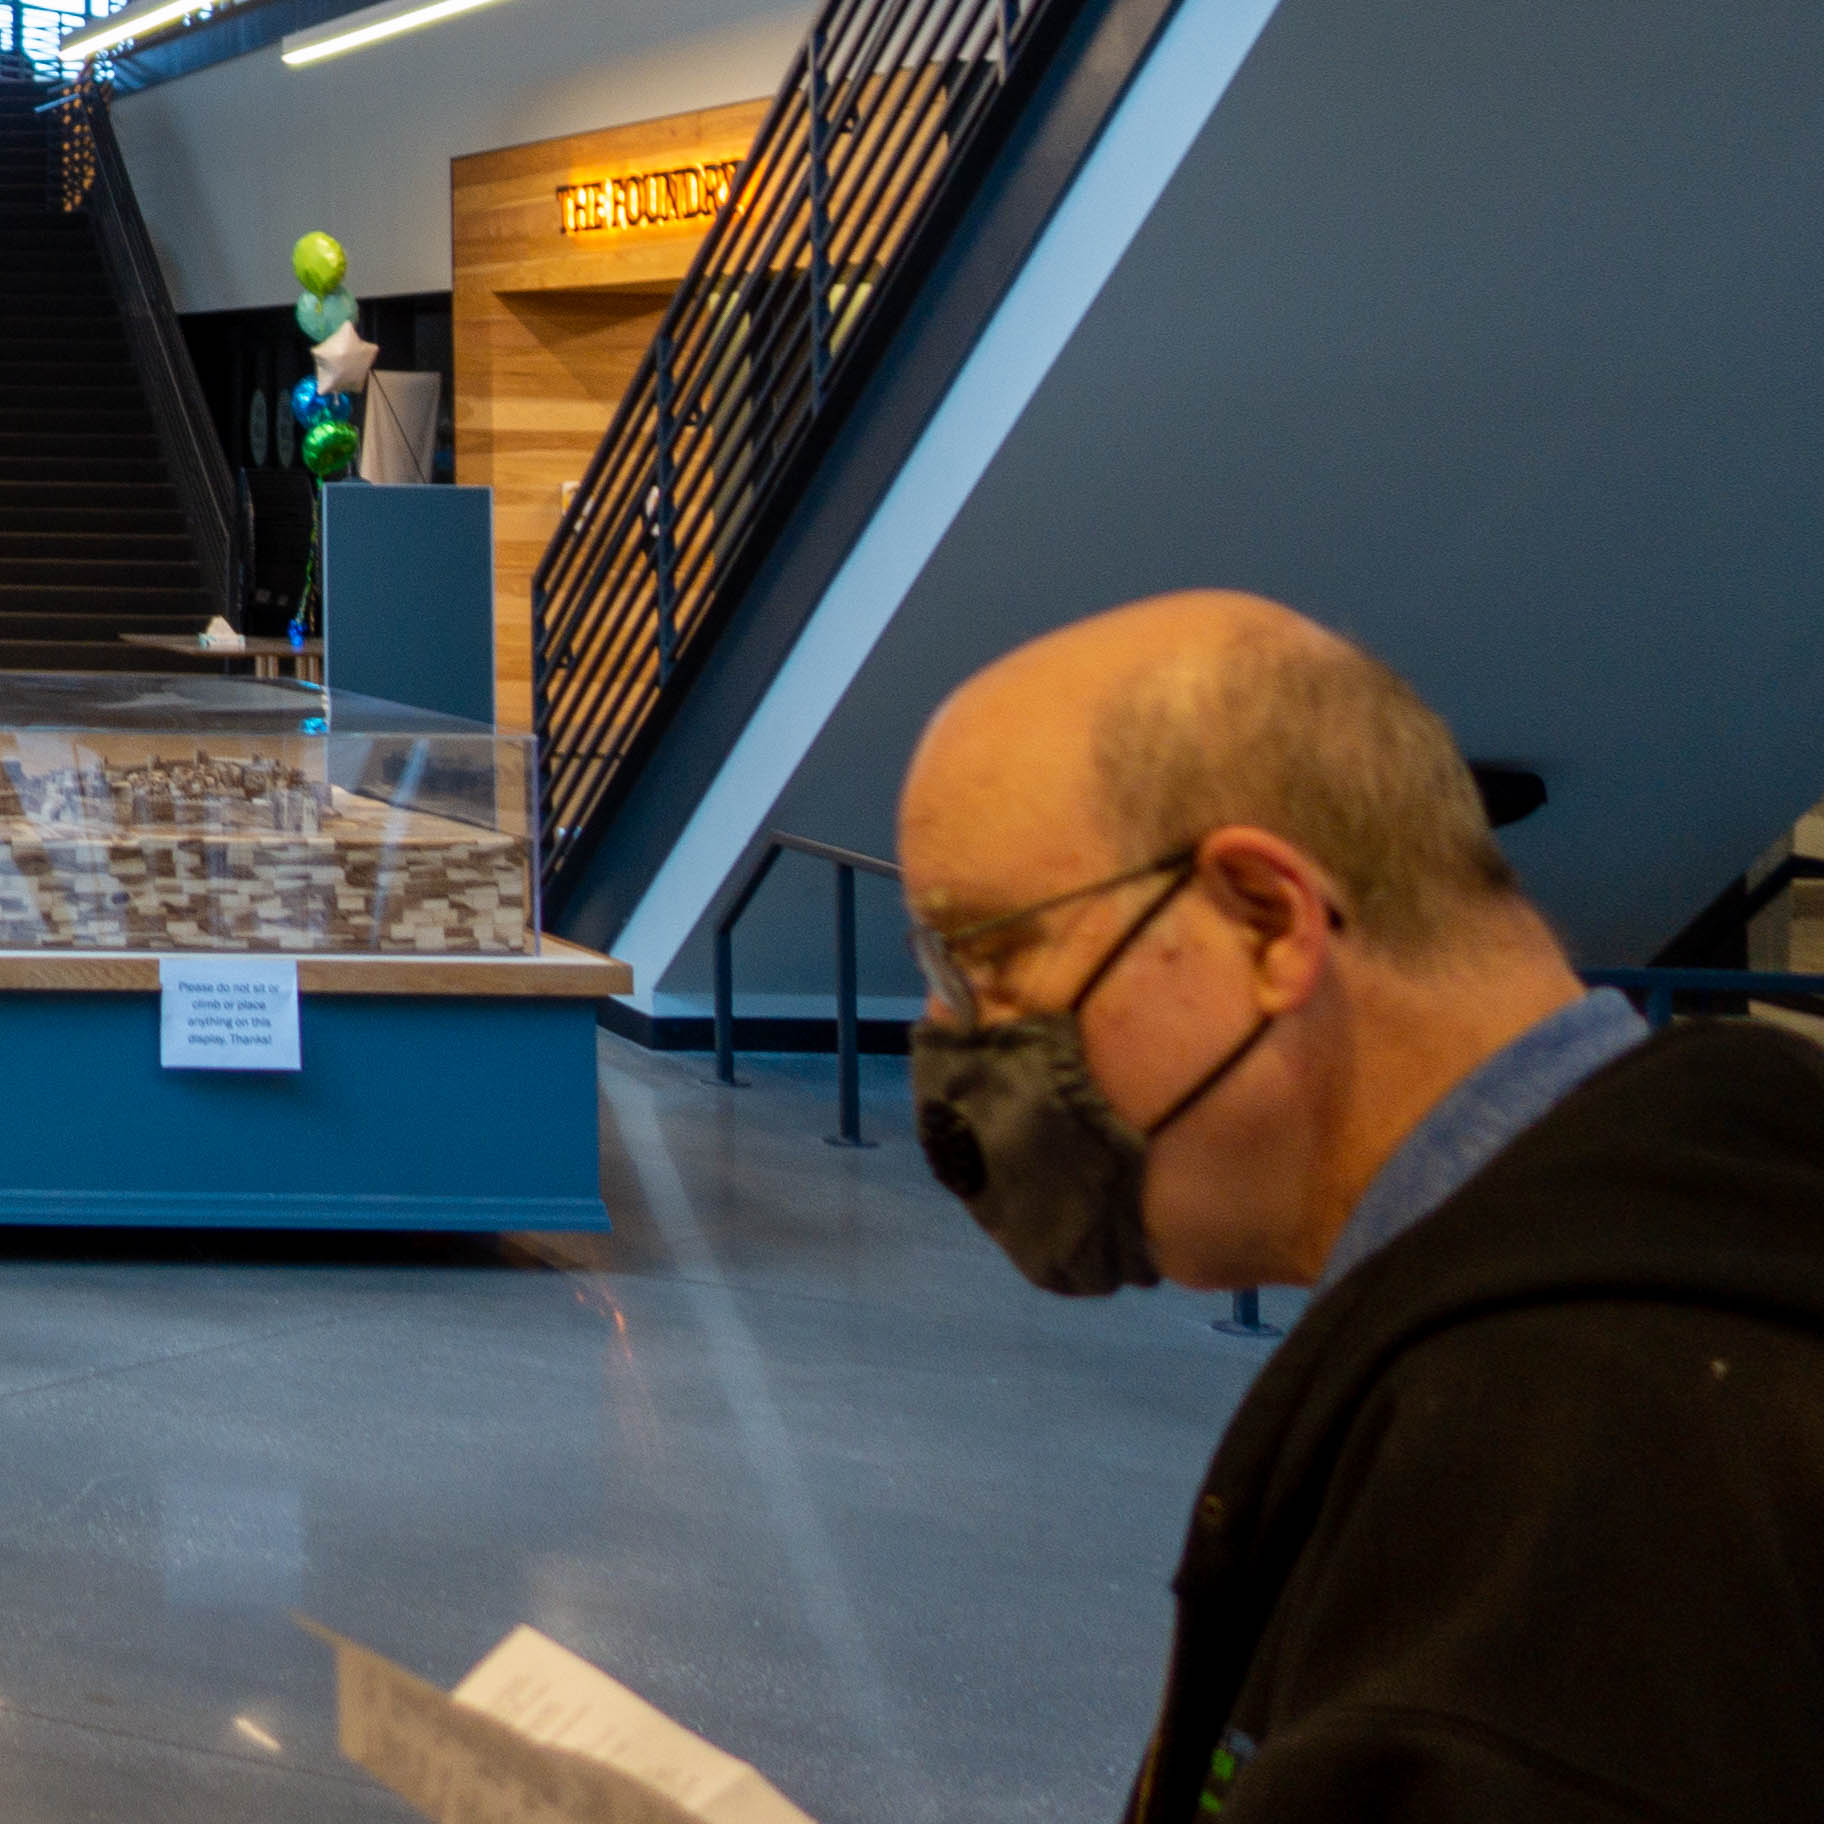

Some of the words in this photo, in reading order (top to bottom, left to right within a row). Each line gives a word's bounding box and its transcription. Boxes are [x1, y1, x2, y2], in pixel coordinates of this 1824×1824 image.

[557, 183, 604, 233] THE
[178, 981, 214, 993] Please
[216, 983, 231, 993] do
[233, 983, 250, 993] not
[253, 983, 266, 993] sit
[268, 984, 280, 993] or
[192, 1000, 221, 1010] climb
[223, 1001, 234, 1010] or
[237, 1000, 266, 1012] place
[187, 1017, 232, 1029] anything
[234, 1018, 249, 1028] on
[251, 1017, 271, 1028] this
[230, 1033, 272, 1046] Thanks!
